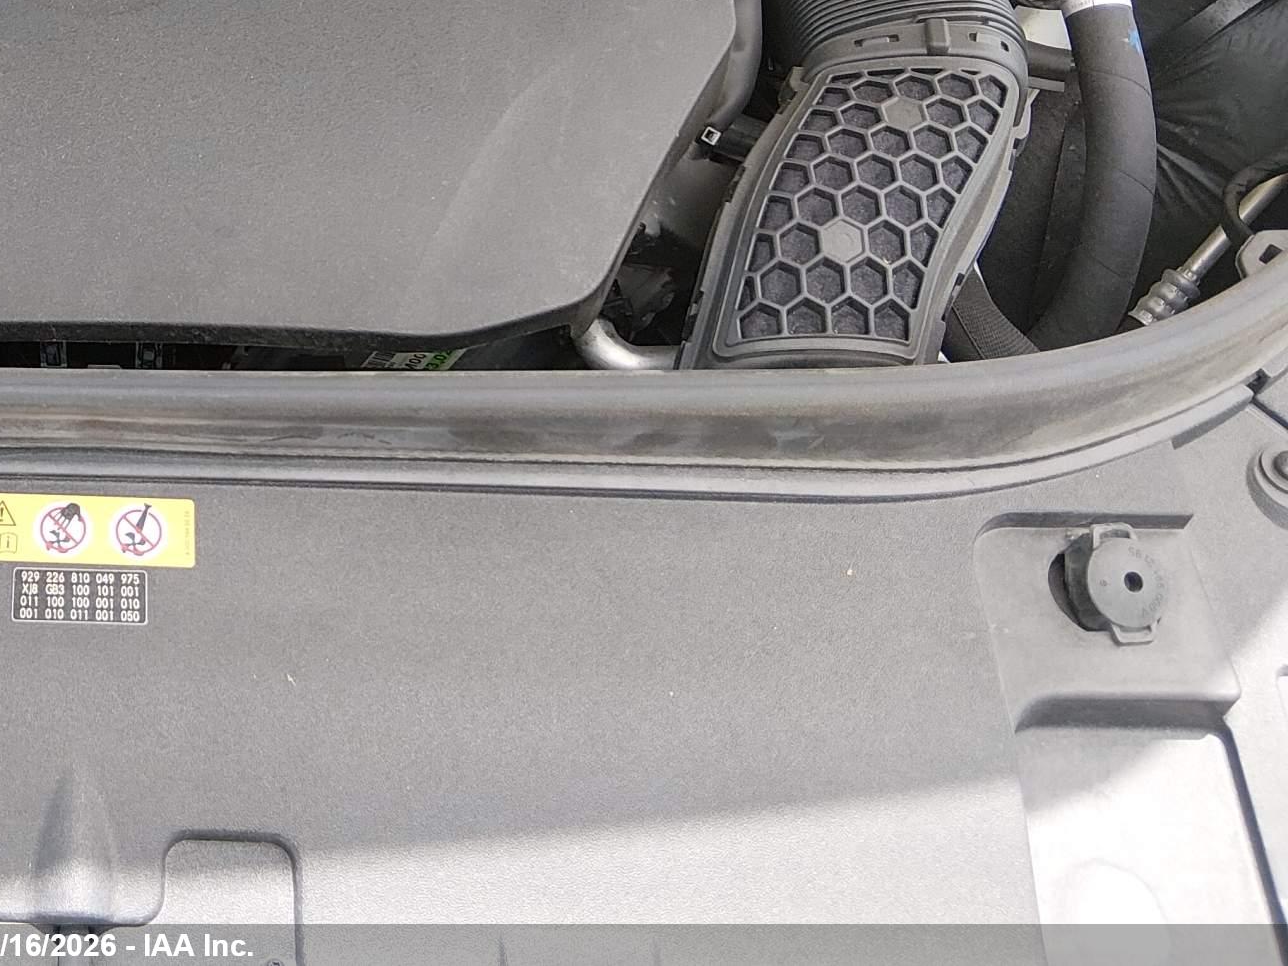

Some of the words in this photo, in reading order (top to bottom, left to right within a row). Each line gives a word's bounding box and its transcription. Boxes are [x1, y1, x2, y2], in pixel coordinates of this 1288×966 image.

[22, 571, 40, 582] 929
[46, 572, 65, 583] 226
[71, 572, 90, 584] 810
[96, 573, 115, 584] 049
[121, 574, 140, 585] 975
[22, 583, 38, 596] XJ8
[46, 584, 65, 595] GB3
[73, 585, 90, 596] 100
[98, 586, 114, 597] 101
[121, 586, 139, 597] 001
[20, 596, 38, 607] 011
[47, 597, 64, 608] 100
[72, 597, 90, 608] 100
[96, 598, 114, 609] 001
[121, 598, 140, 609] 010
[20, 608, 38, 619] 001
[45, 609, 64, 620] 010
[71, 610, 88, 621] 011
[96, 610, 114, 621] 001
[121, 611, 140, 622] 050
